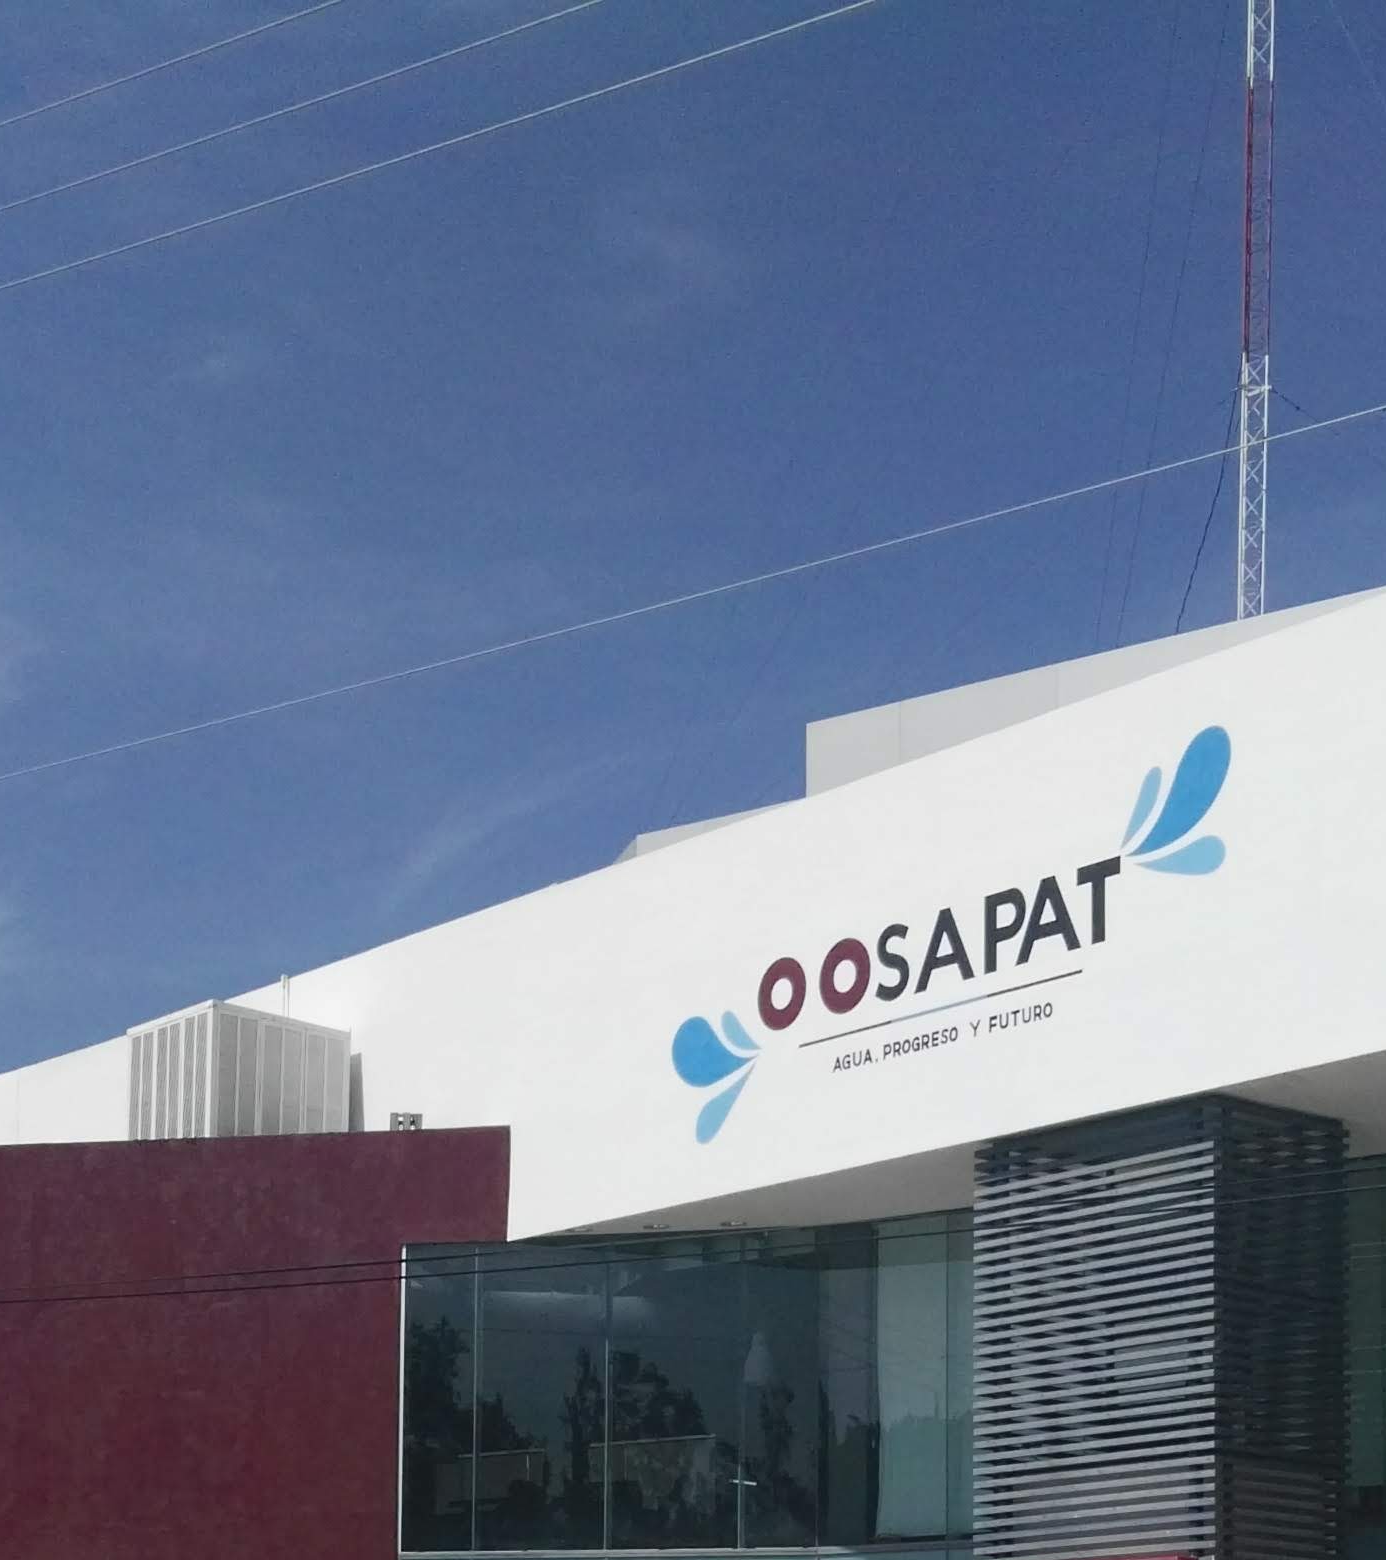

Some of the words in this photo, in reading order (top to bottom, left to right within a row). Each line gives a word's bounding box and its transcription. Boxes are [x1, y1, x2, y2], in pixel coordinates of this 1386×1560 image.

[758, 856, 1121, 1031] OOSAPAT
[883, 1026, 959, 1060] PROGRESO
[969, 1019, 983, 1036] Y
[988, 1002, 1054, 1032] FUTURO
